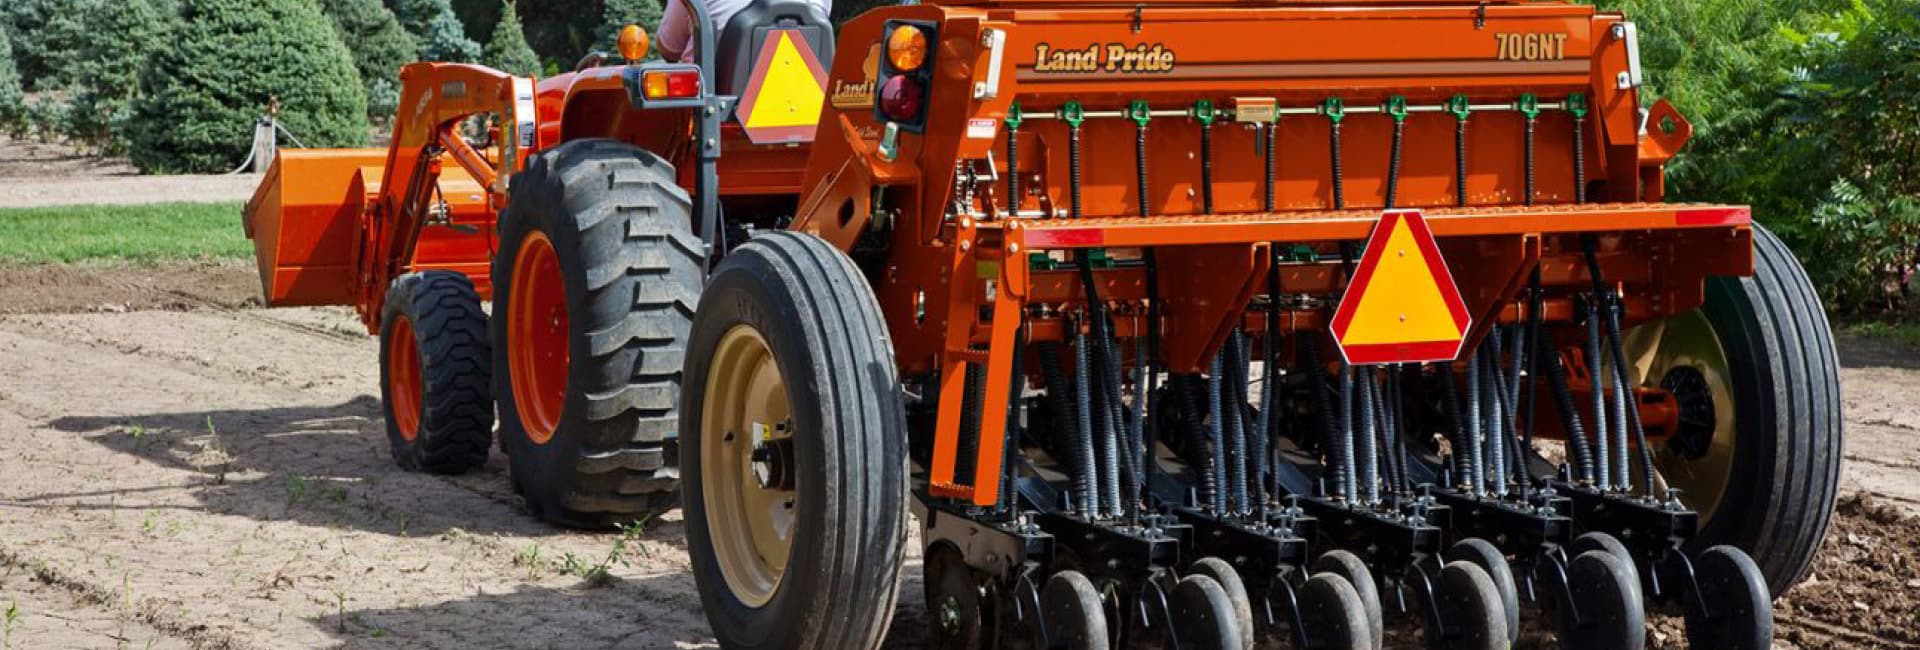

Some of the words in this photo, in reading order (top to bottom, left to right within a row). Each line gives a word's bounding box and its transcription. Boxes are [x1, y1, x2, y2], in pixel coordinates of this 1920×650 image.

[1034, 43, 1099, 72] Land
[1105, 43, 1175, 72] Pride
[1495, 32, 1567, 60] 706NT
[835, 79, 868, 97] Land
